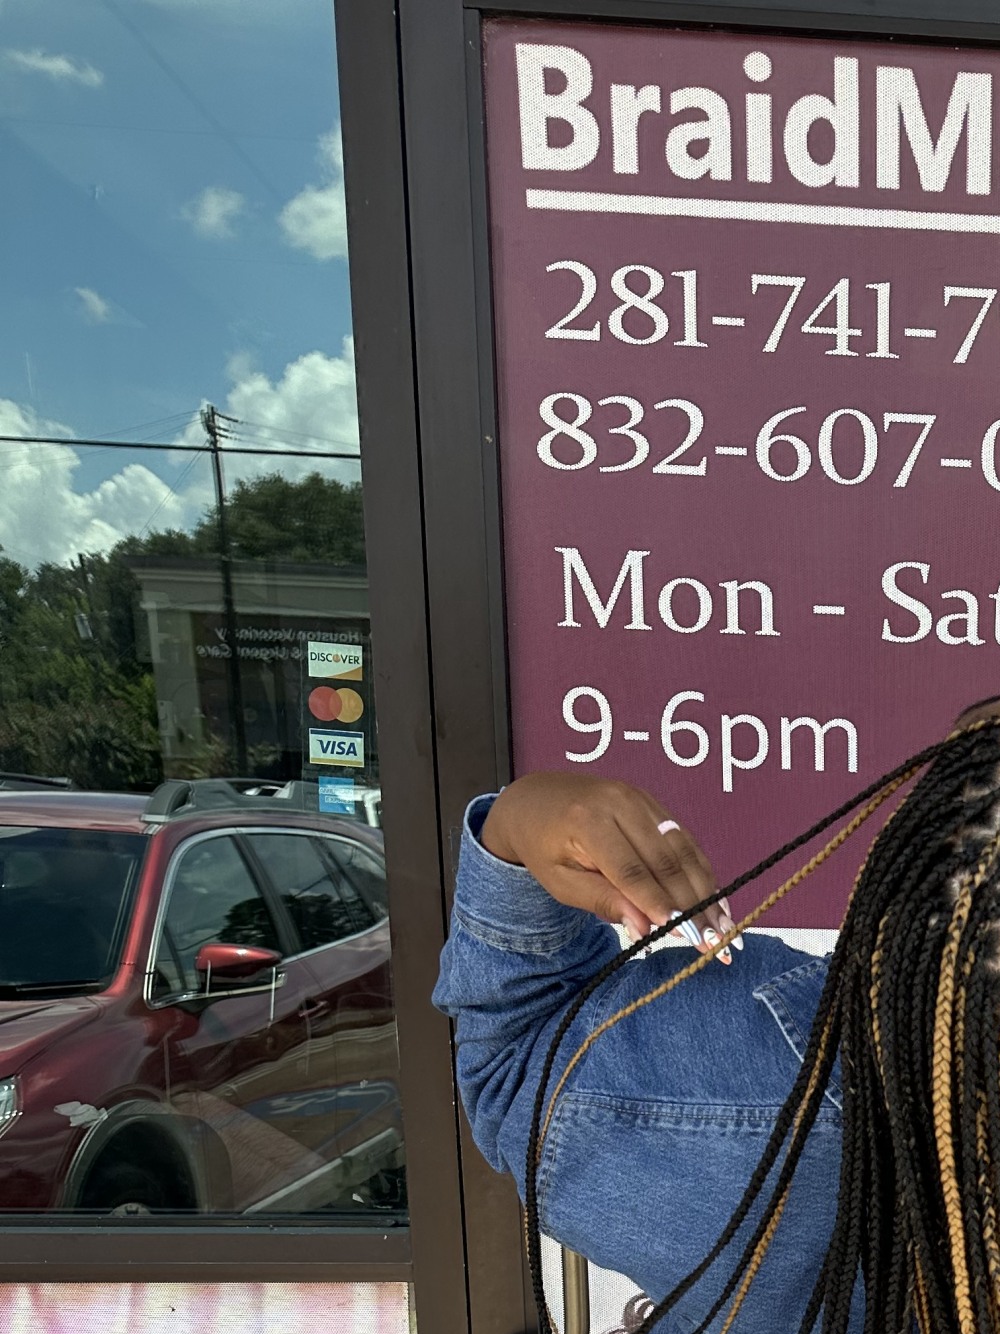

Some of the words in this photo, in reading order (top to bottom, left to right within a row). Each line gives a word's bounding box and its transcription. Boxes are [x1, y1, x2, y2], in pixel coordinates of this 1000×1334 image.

[555, 546, 781, 637] Mon
[812, 604, 845, 616] -
[310, 651, 360, 665] DISCOVER
[316, 739, 358, 756] VISA
[562, 685, 860, 793] 9-6pm
